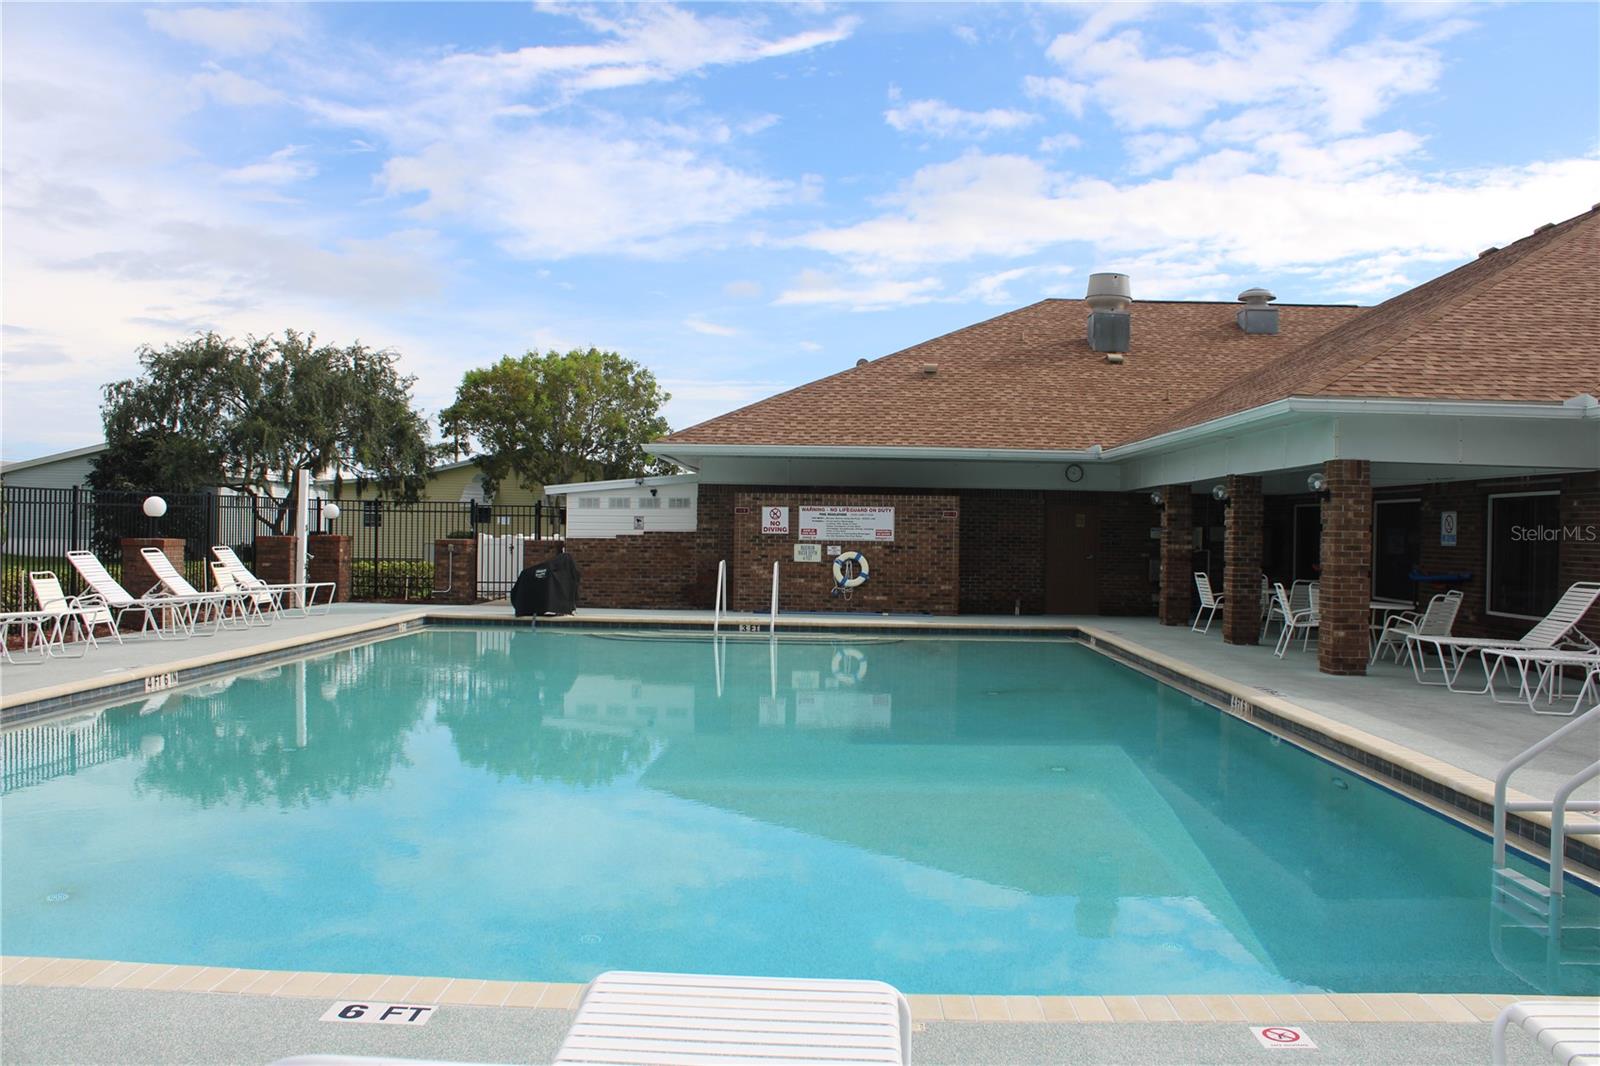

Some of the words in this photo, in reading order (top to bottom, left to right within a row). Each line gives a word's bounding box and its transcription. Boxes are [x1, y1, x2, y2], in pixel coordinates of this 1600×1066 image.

[742, 624, 747, 632] 3
[147, 676, 152, 688] 4
[154, 673, 162, 687] FT
[164, 672, 169, 686] 6
[338, 1004, 369, 1019] 6
[379, 1006, 432, 1022] FT
